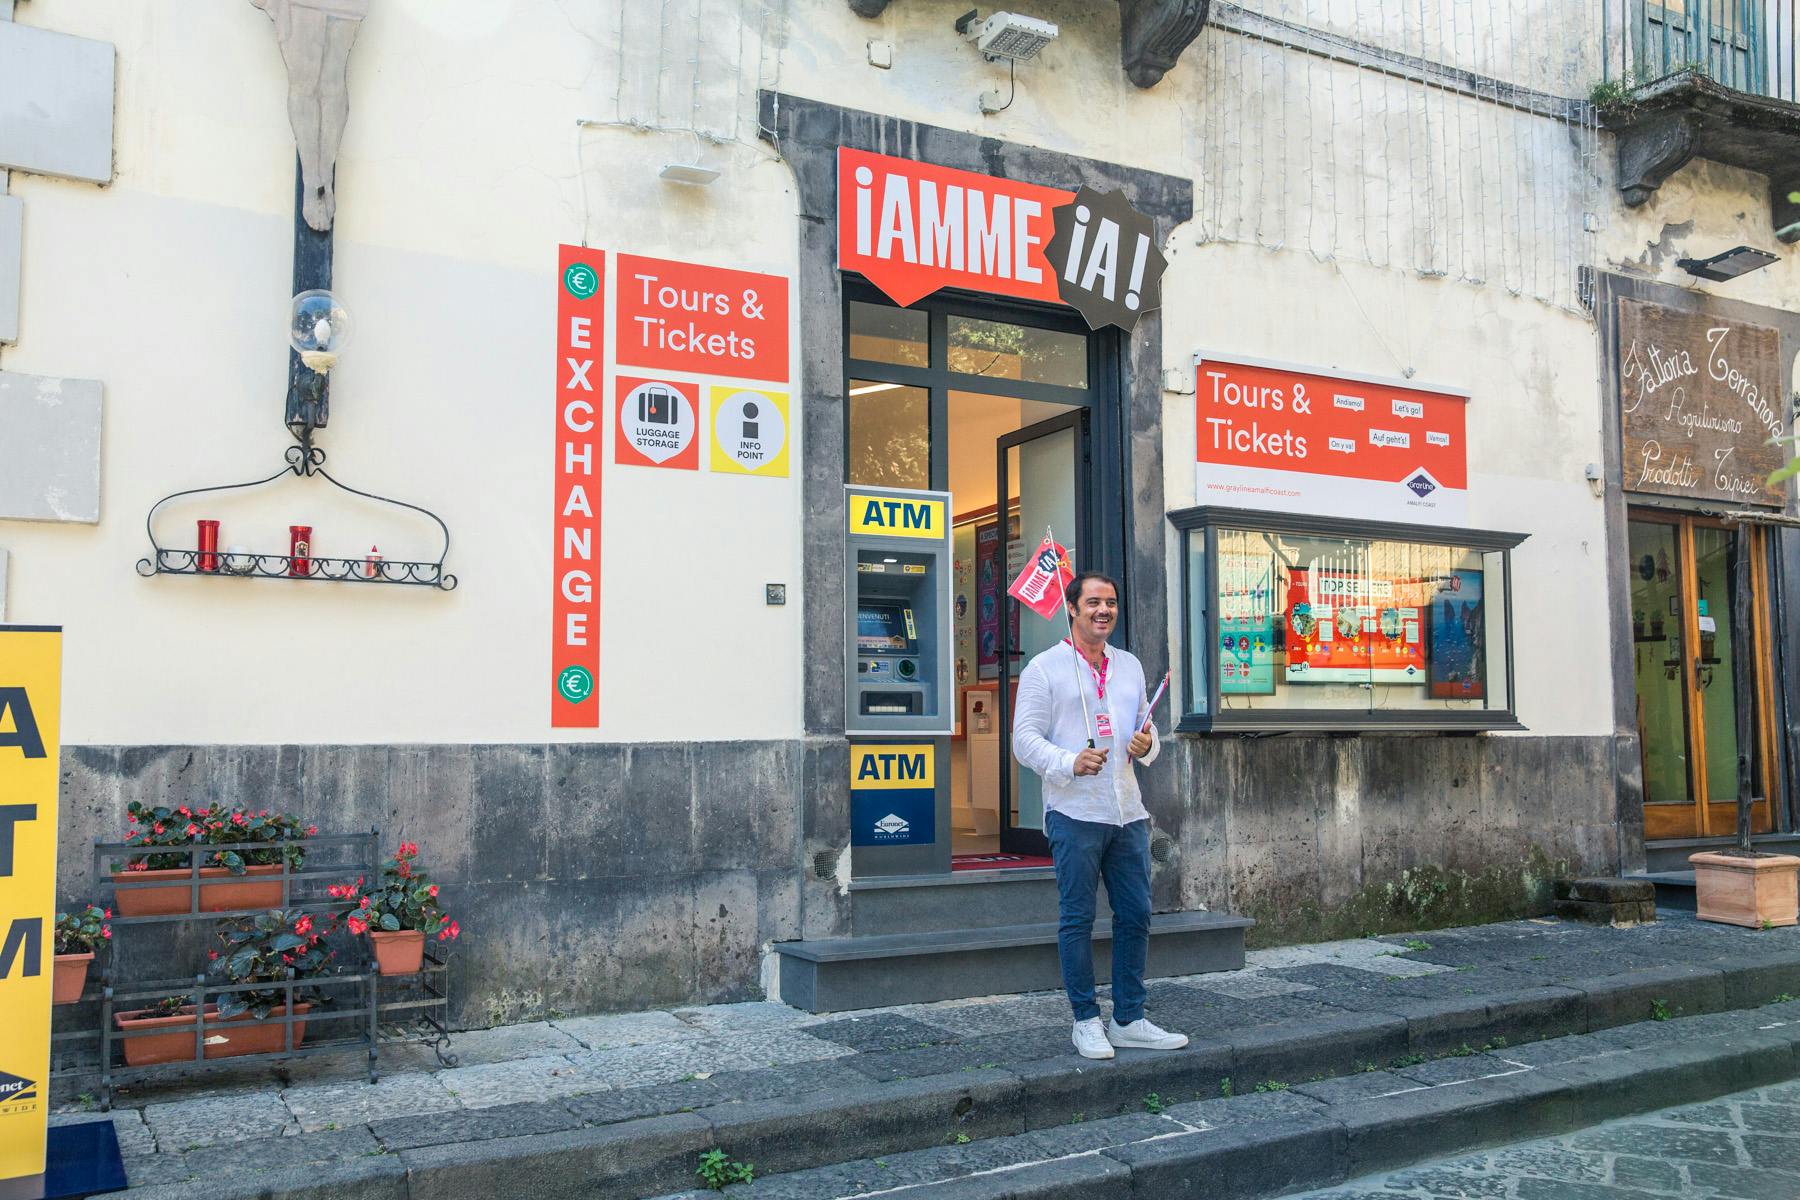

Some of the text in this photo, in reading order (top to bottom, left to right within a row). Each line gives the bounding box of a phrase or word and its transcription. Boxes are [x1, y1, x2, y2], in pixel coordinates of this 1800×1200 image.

[634, 274, 765, 320] Tours &
[634, 316, 755, 359] Tickets
[1206, 371, 1312, 415] Tours &
[1707, 327, 1784, 447] Terranova
[1336, 398, 1362, 408] Andiamo!
[1394, 403, 1421, 416] Let's go!
[1664, 387, 1743, 437] Agriturismo
[636, 428, 680, 439] LUGGAGE
[636, 438, 680, 449] STORAGE
[740, 441, 761, 451] INFO
[1206, 417, 1308, 459] Tickets
[1331, 440, 1340, 448] On
[1373, 432, 1407, 445] Auf geht's!
[737, 450, 764, 460] POINT
[561, 316, 595, 646] EXCHANGE
[1637, 440, 1759, 499] Prodotti Tipici
[862, 500, 931, 529] ATM
[1321, 580, 1344, 592] TOP
[1346, 580, 1389, 596] SEERS
[857, 753, 925, 780] ATM
